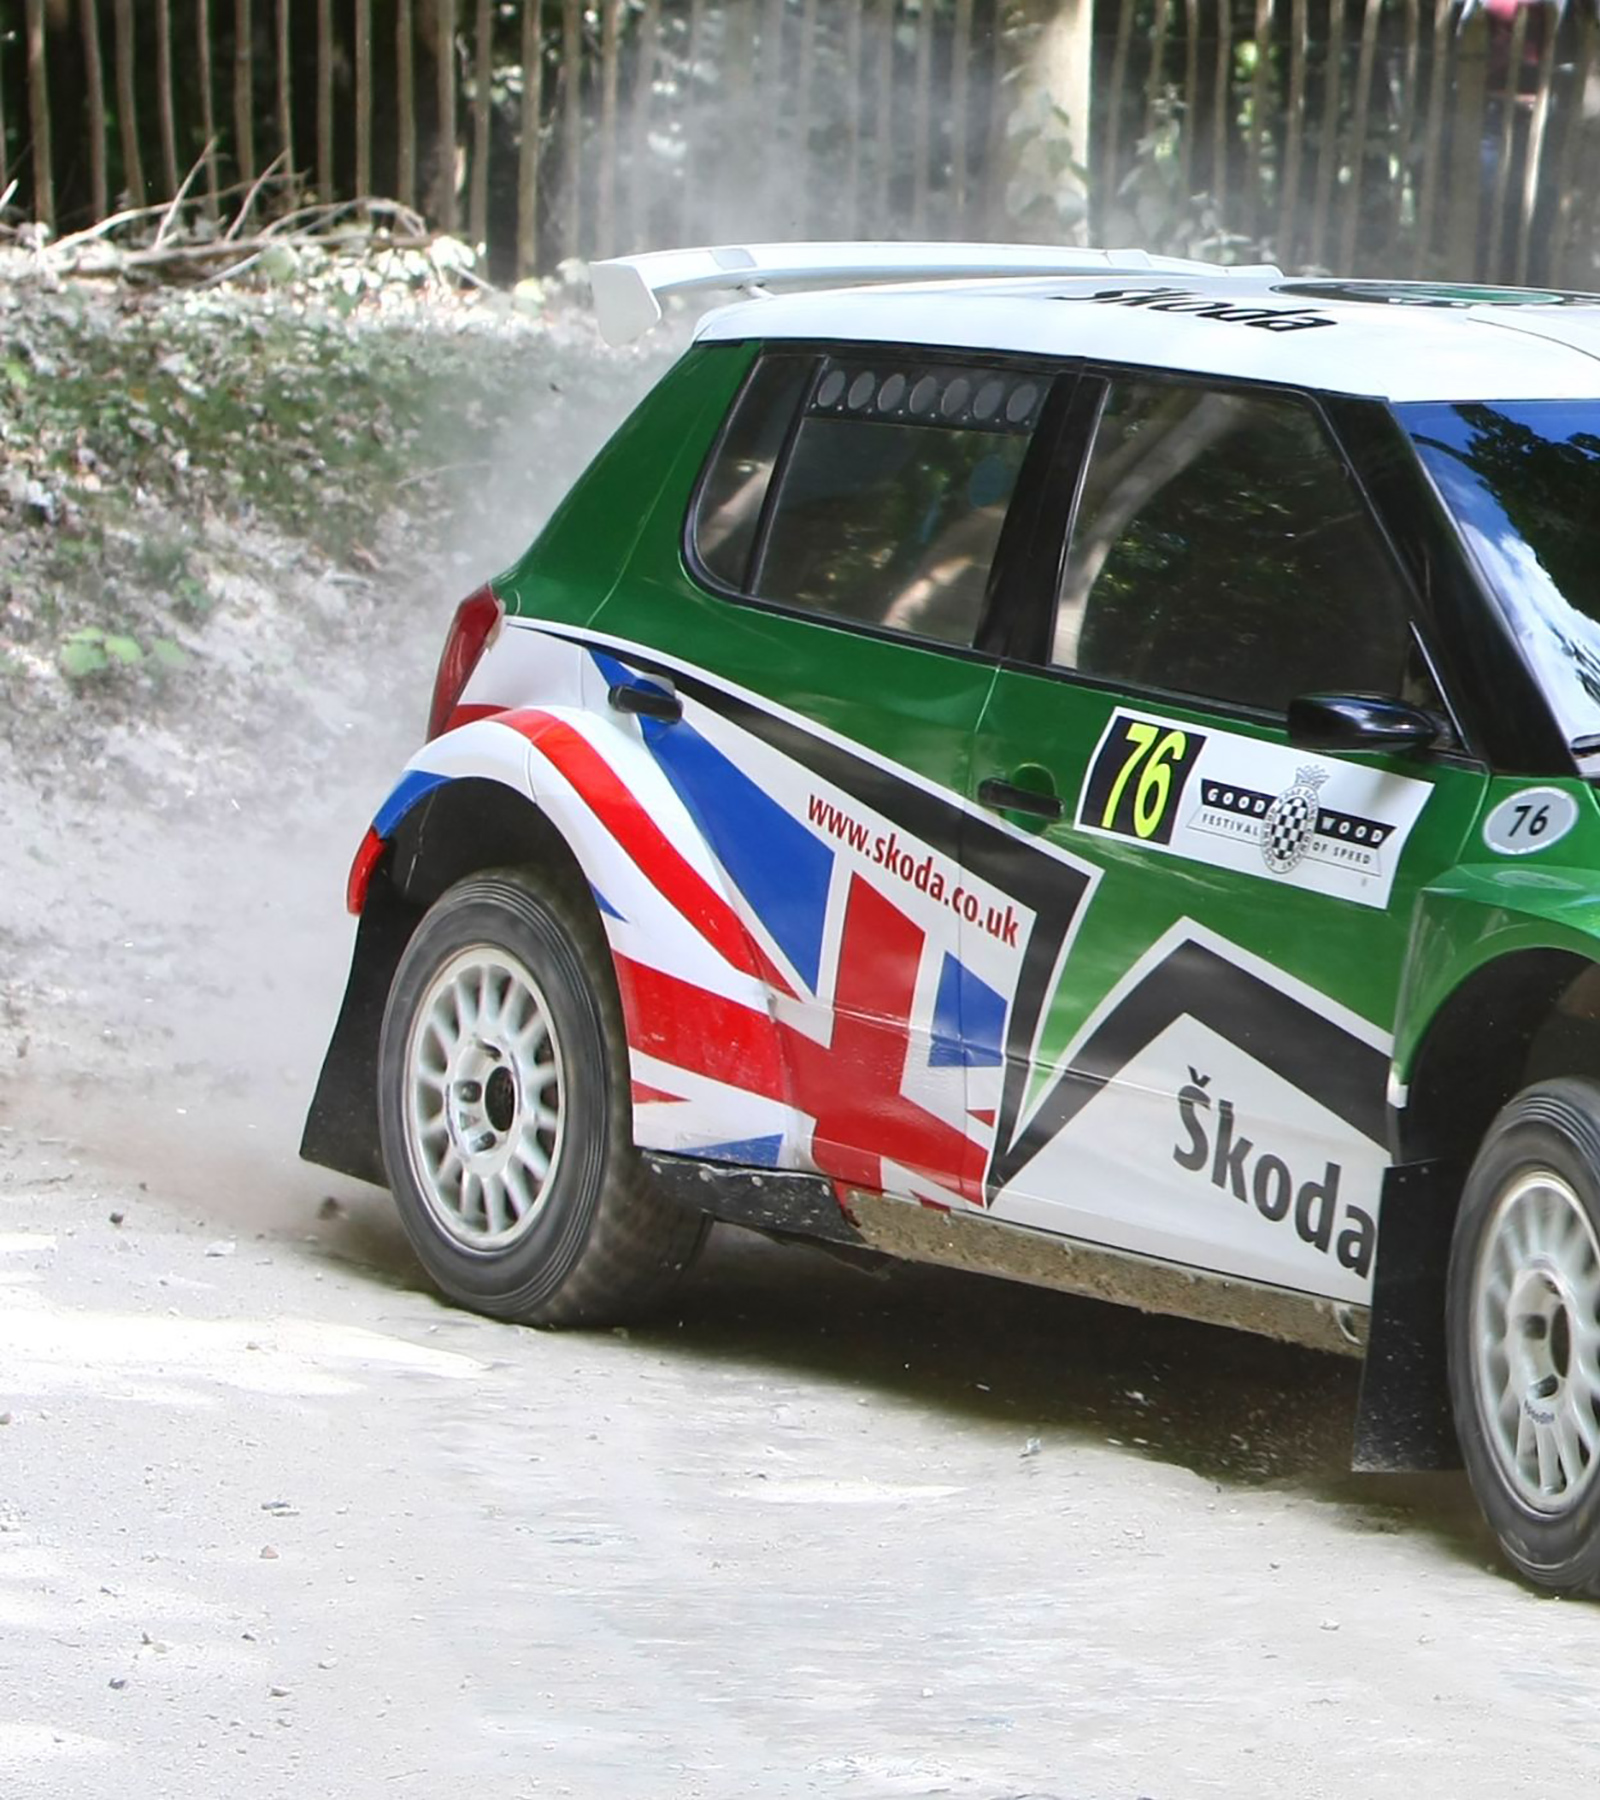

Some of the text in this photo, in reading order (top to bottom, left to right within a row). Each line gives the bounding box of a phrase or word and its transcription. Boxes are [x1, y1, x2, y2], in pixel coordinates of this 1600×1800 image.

[1101, 723, 1186, 838] 76
[1507, 804, 1549, 837] 76
[807, 793, 1019, 949] www.skoda.co.uk
[1202, 813, 1371, 865] FESTIVAL OF SPEED
[1172, 1065, 1376, 1280] Škoda
